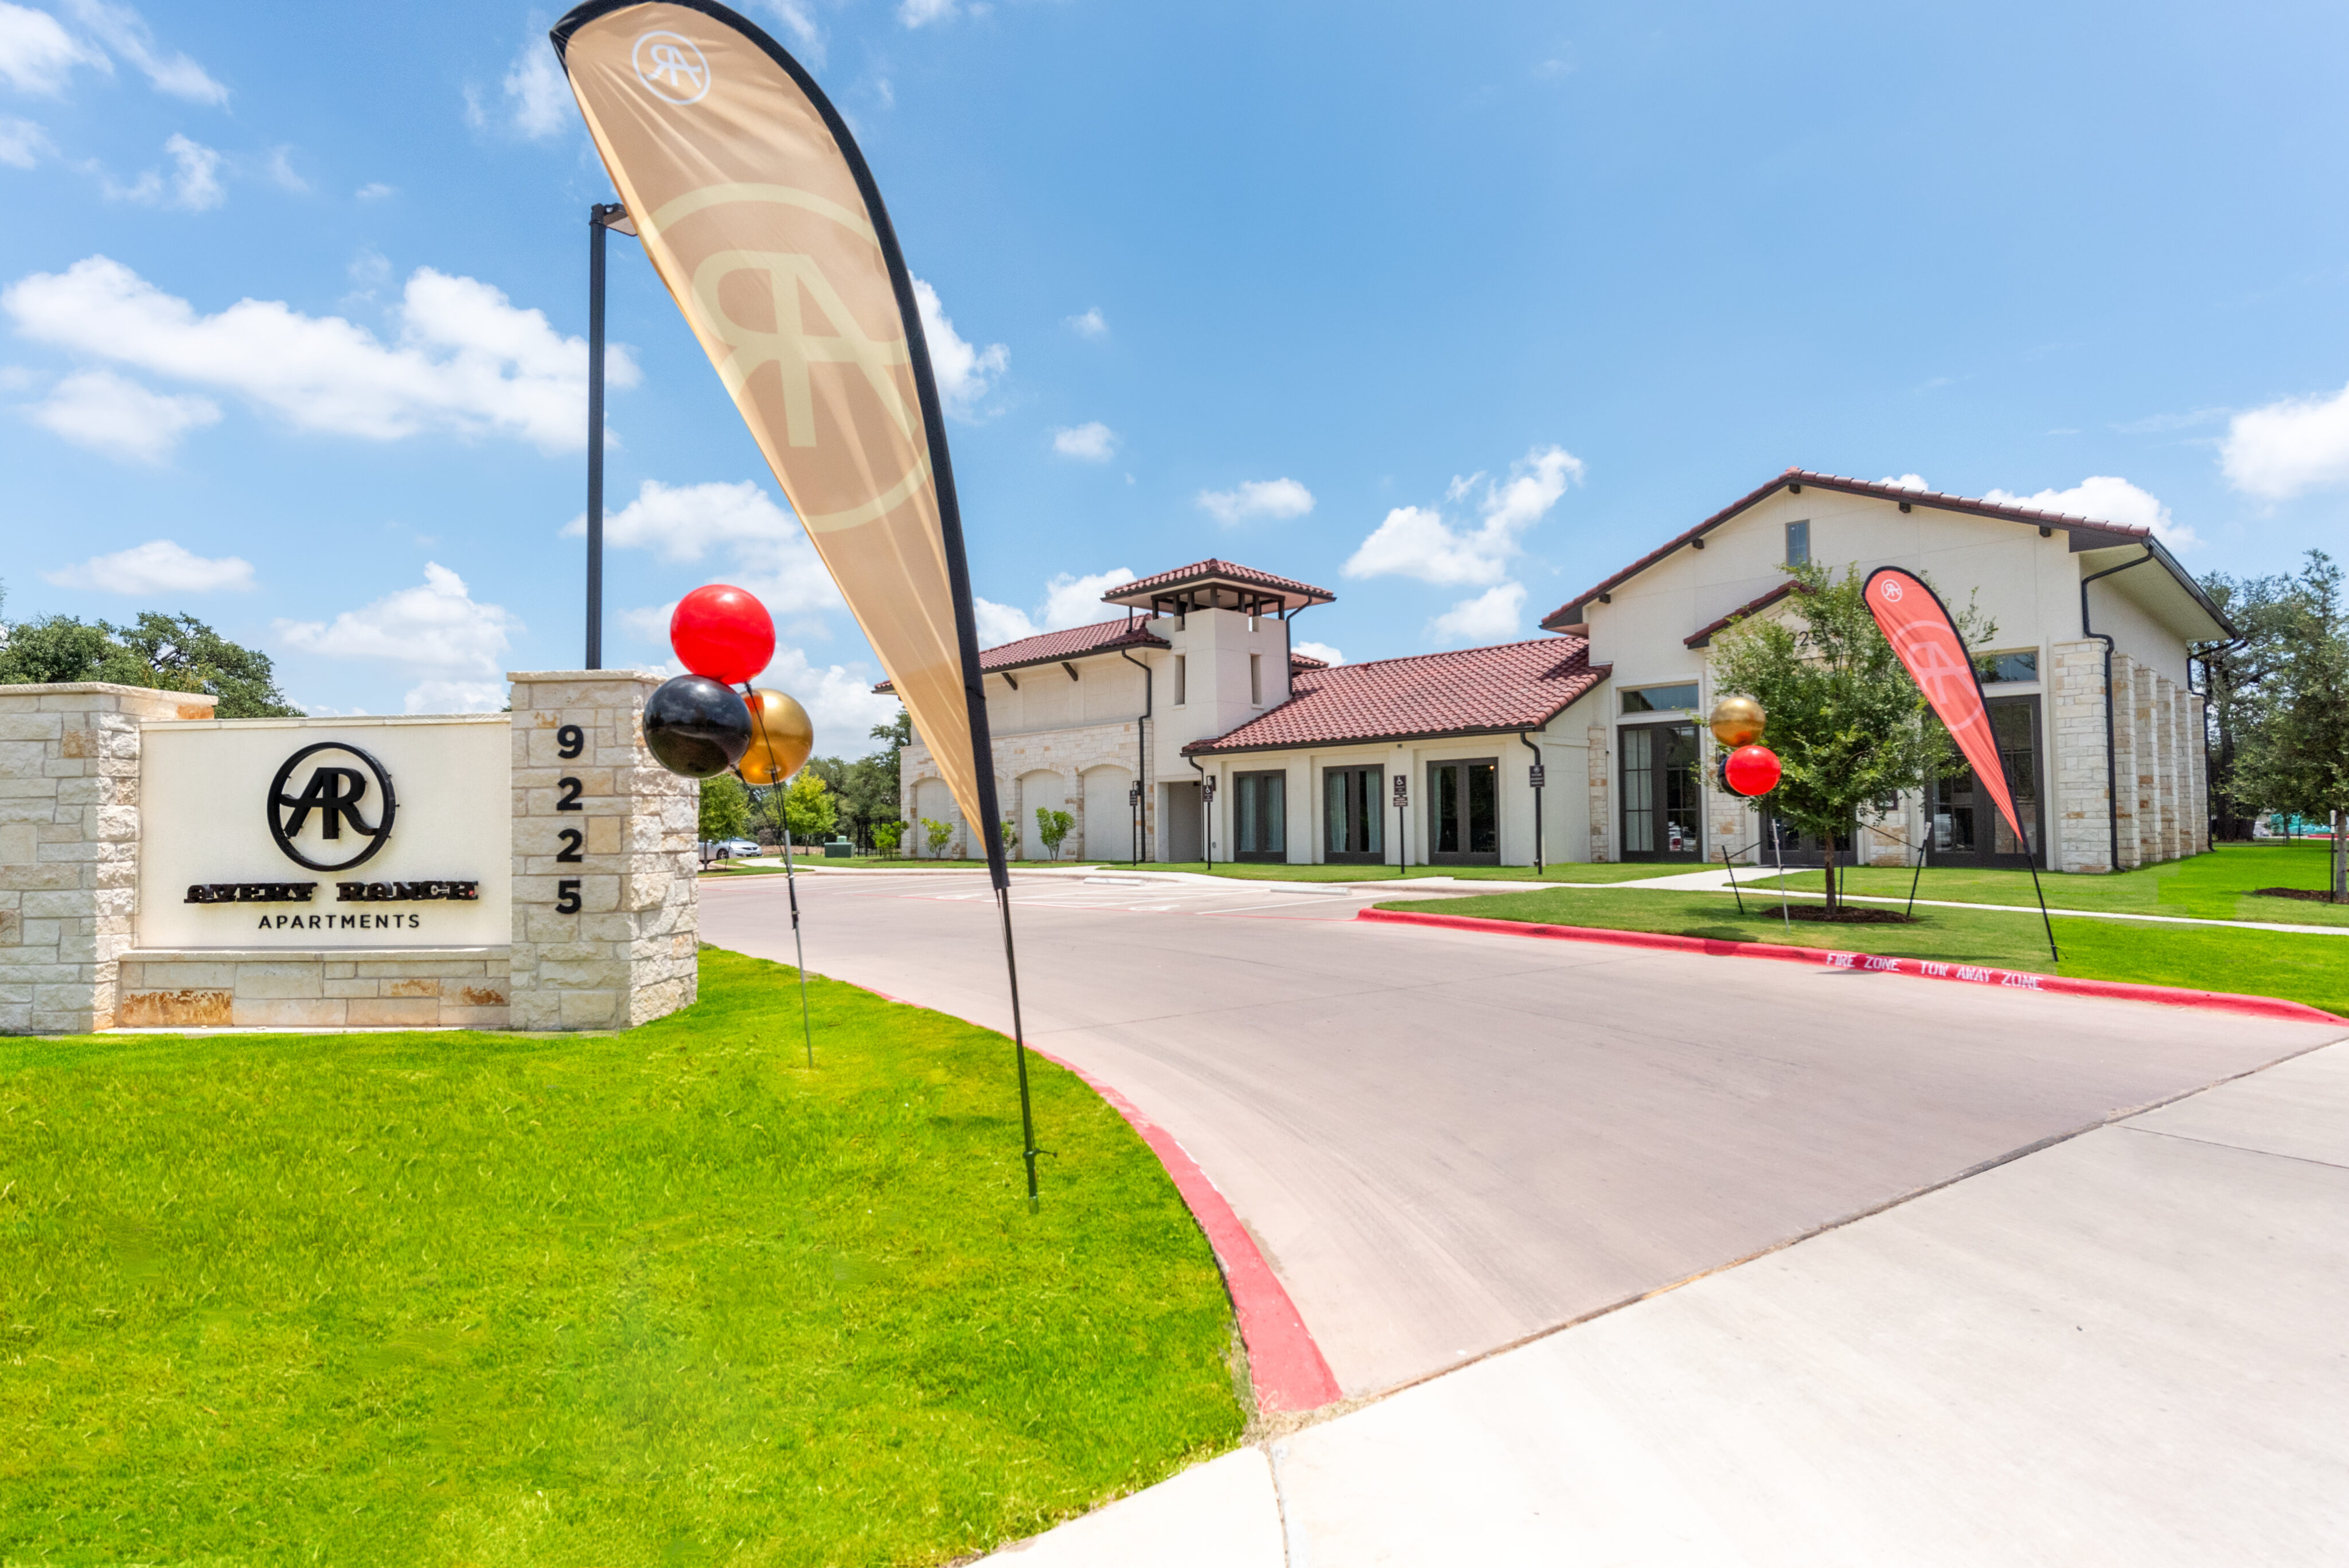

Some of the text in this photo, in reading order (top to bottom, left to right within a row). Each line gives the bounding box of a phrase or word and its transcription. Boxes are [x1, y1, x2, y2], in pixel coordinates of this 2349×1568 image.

[280, 767, 381, 840] AR
[336, 880, 478, 901] RANCH
[258, 914, 420, 929] APARTMENTS
[1826, 953, 2043, 990] FIRE ZONE TOW AWAY ZONE
